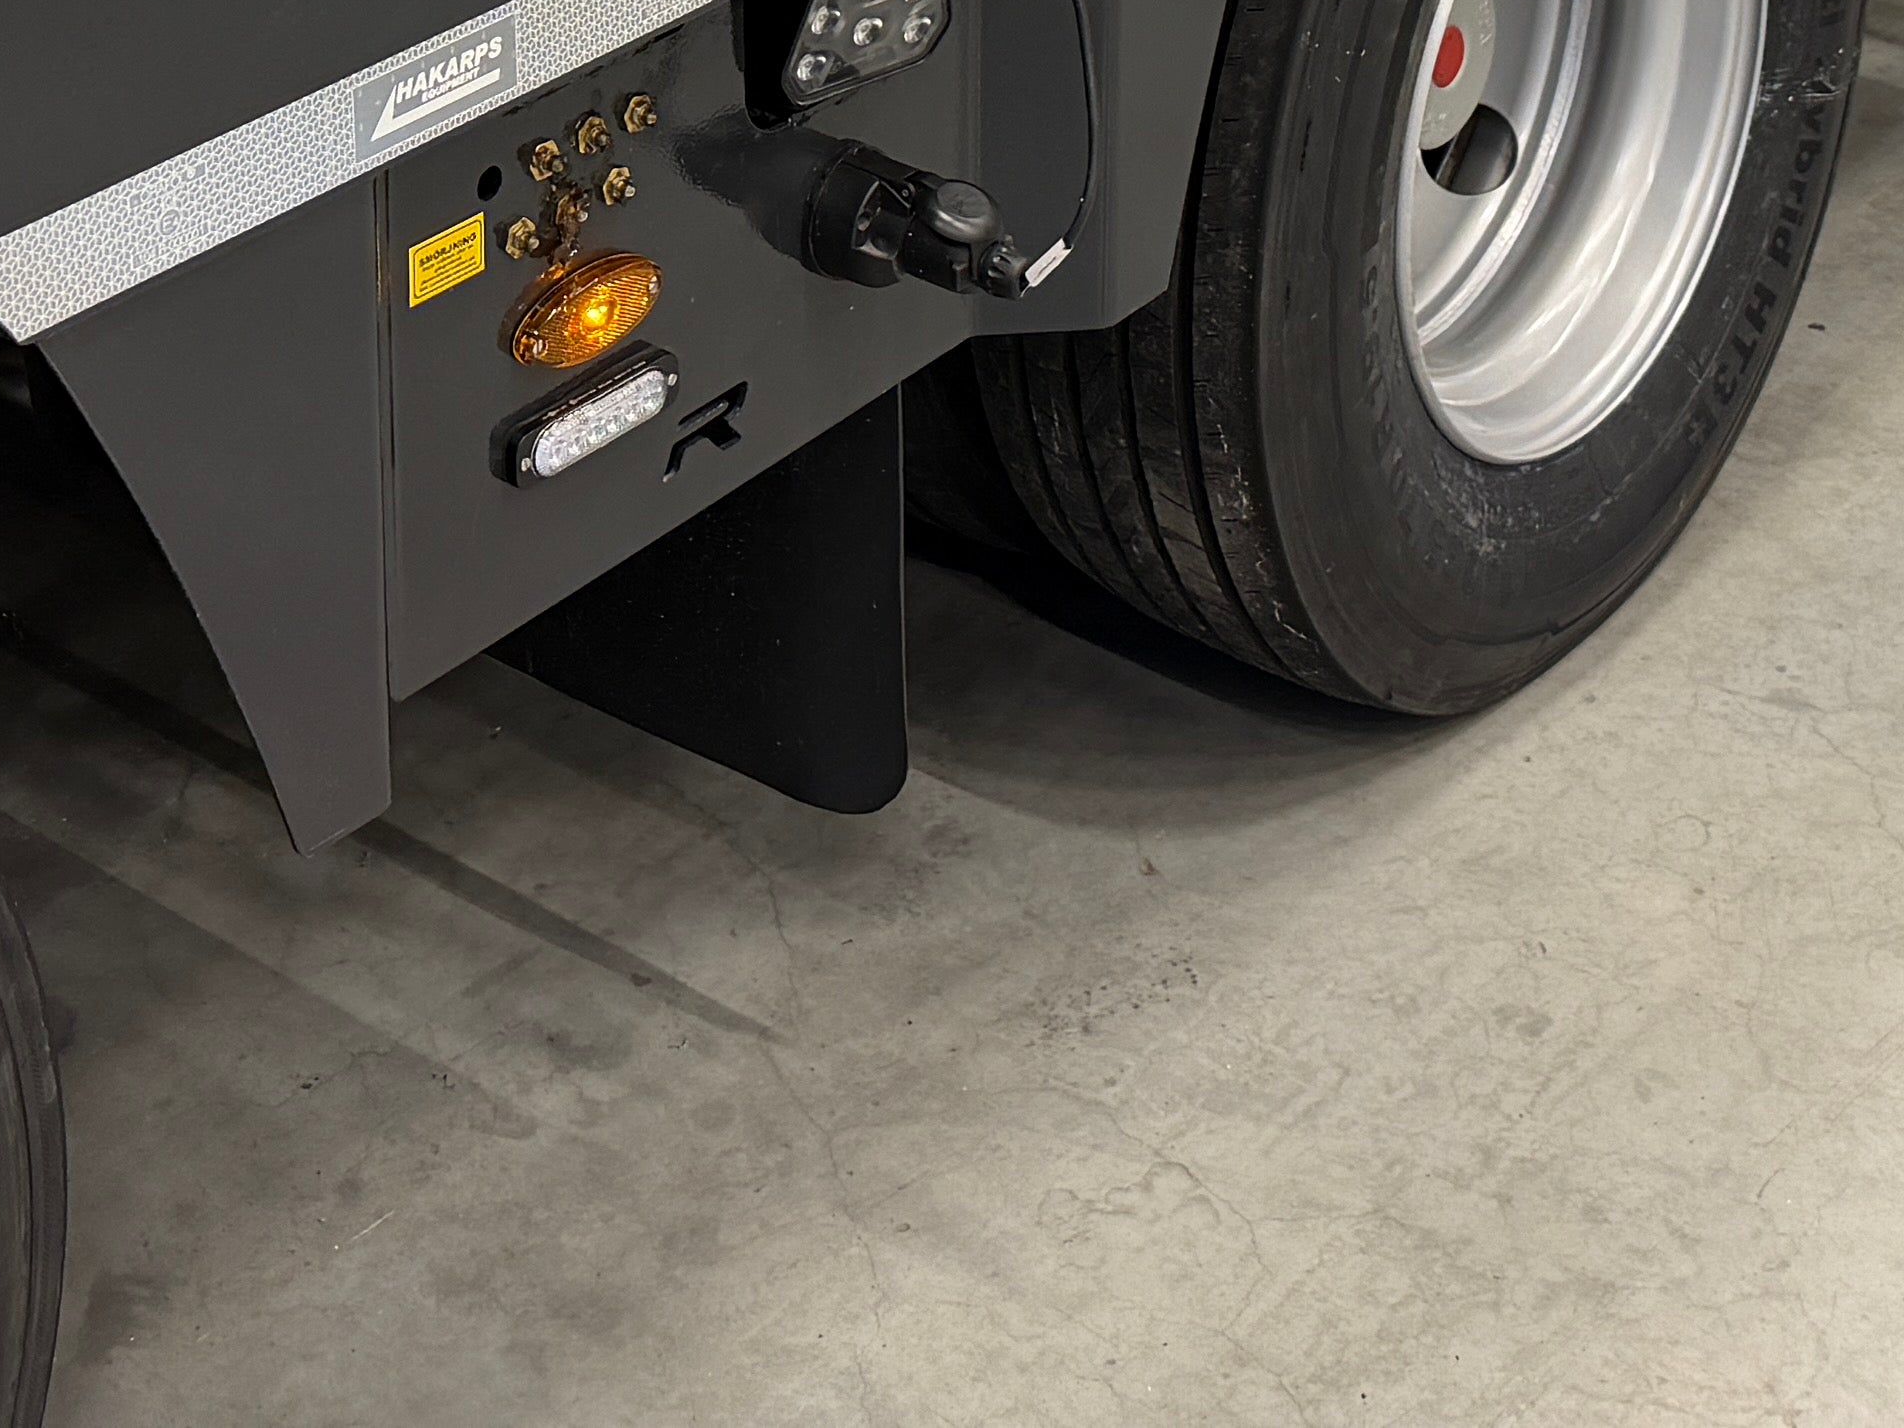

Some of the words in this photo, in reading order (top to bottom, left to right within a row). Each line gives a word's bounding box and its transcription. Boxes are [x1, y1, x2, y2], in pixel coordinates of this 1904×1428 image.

[395, 36, 503, 105] HAKARPS
[421, 65, 481, 104] EQUIPMENT
[1772, 52, 1841, 271] ybrid
